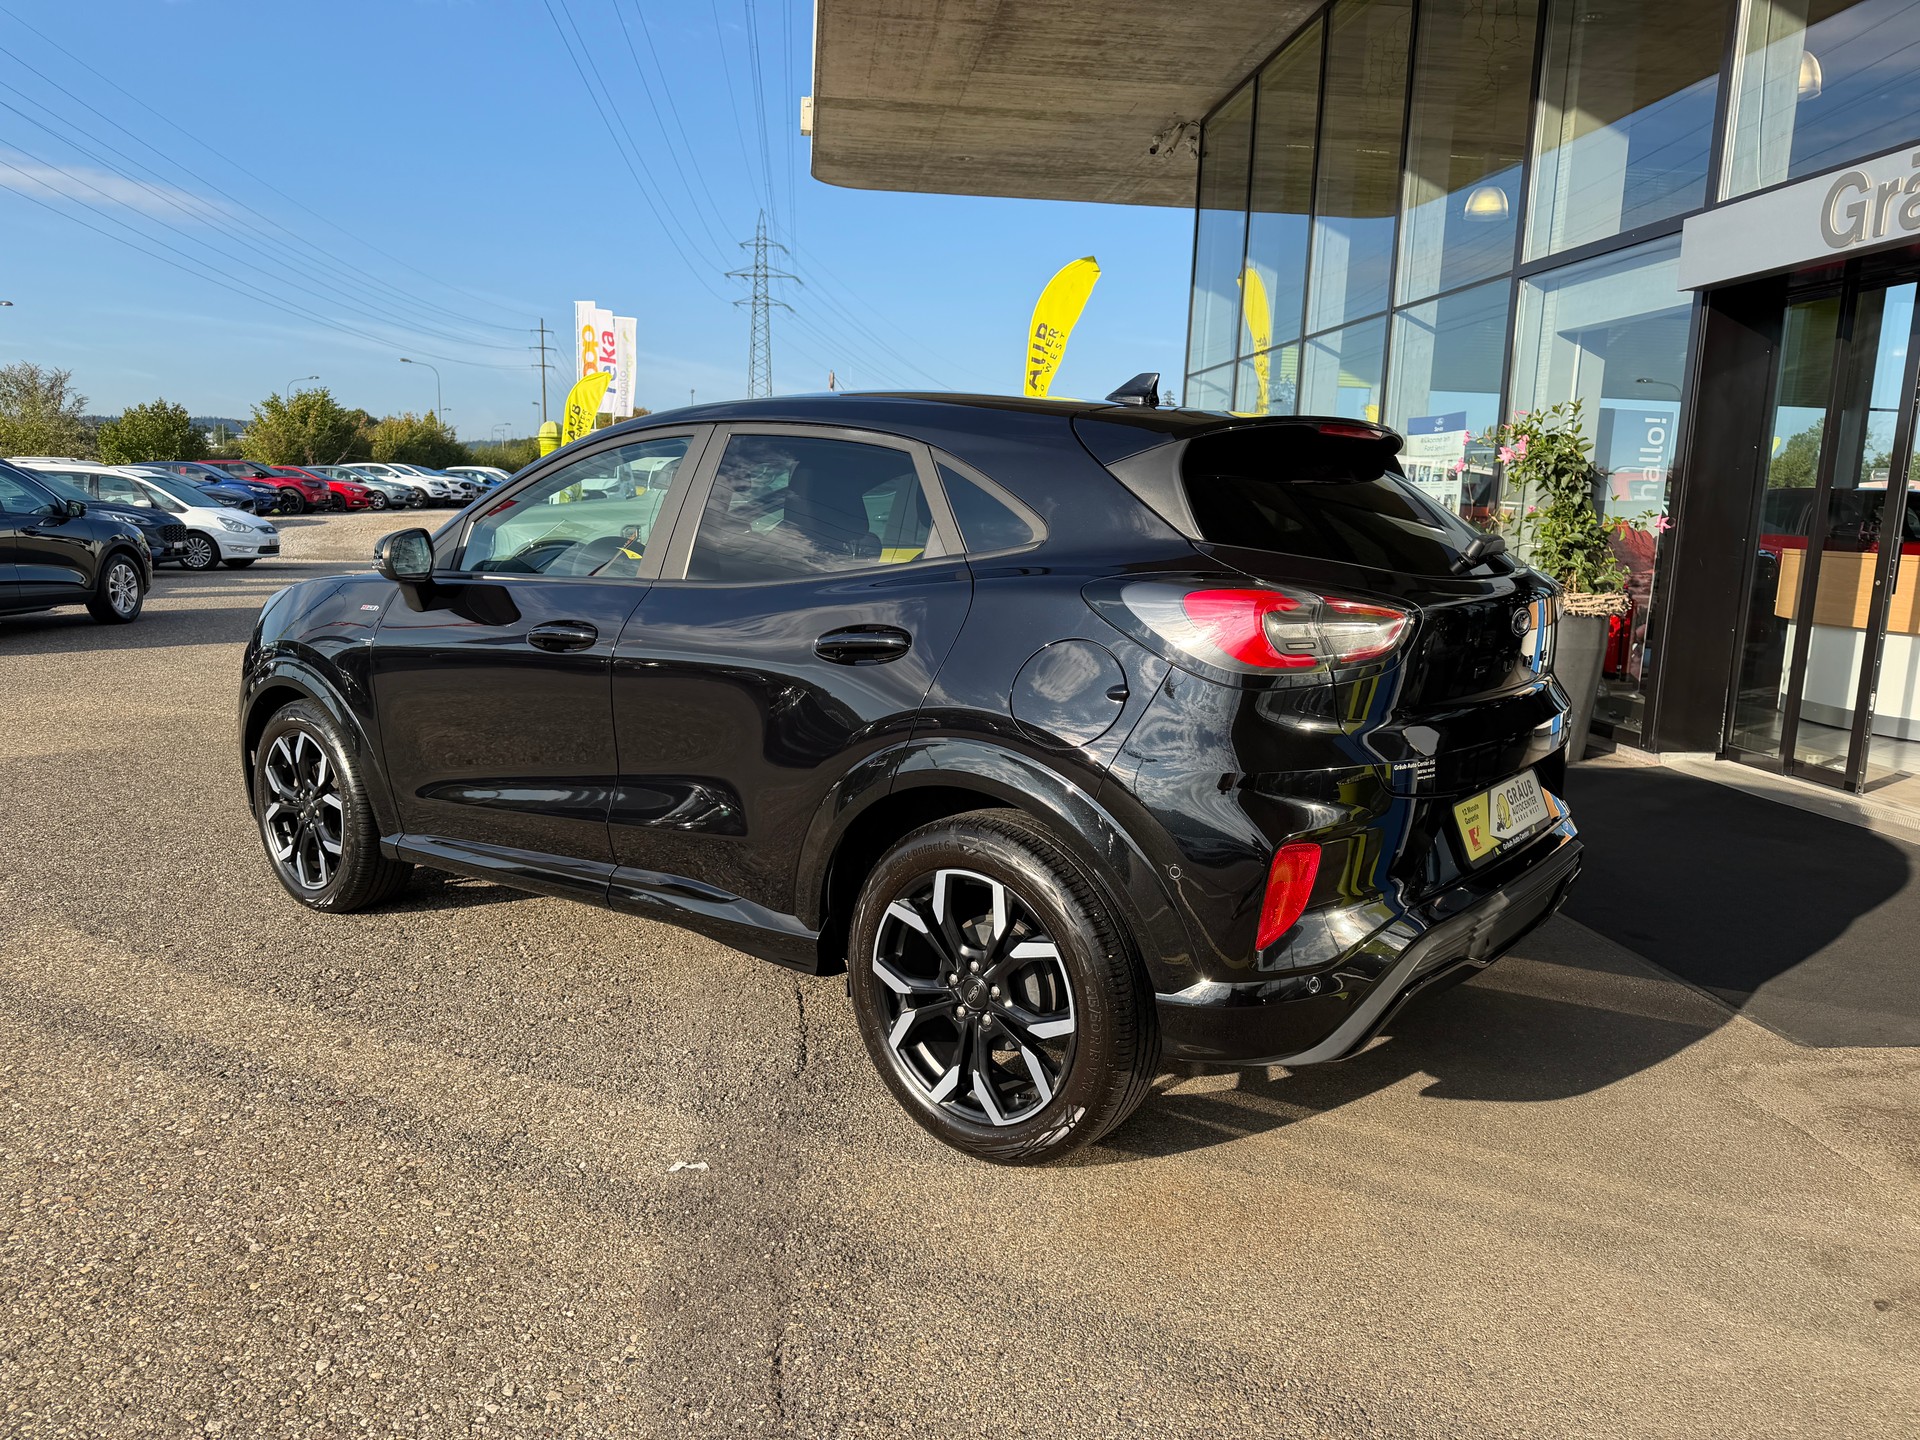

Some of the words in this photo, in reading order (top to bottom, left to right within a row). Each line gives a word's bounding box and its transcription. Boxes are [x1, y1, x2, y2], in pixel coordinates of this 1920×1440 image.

[1045, 333, 1065, 373] WEST
[619, 369, 628, 408] pronto
[1634, 417, 1667, 501] hallo!
[1506, 779, 1534, 806] GRÄUB
[1467, 803, 1480, 815] Monate
[1511, 795, 1538, 816] AUTOCENTER
[1529, 805, 1540, 816] WEST
[1512, 836, 1521, 846] Auto
[1520, 830, 1530, 841] Center
